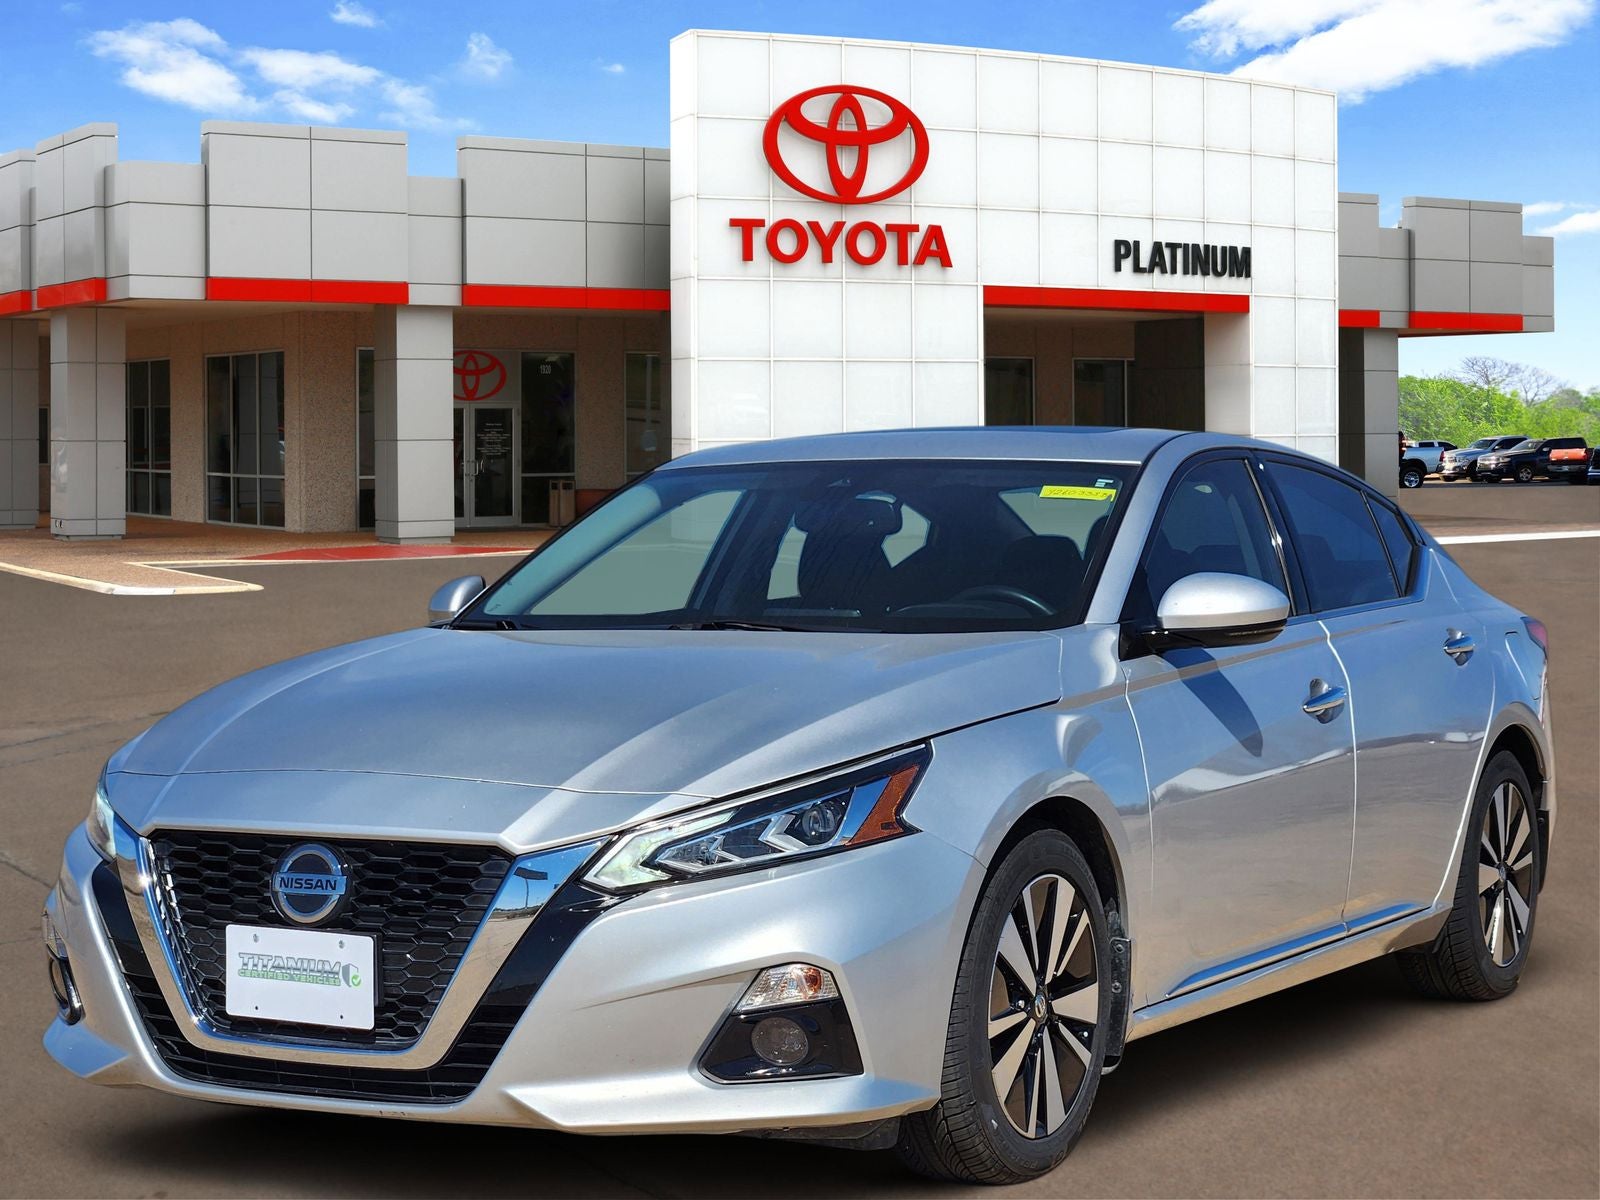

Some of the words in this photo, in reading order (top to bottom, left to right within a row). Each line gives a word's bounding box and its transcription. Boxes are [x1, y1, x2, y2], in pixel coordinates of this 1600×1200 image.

[730, 218, 953, 268] TOYOTA
[1114, 240, 1252, 278] PLATINUM
[279, 877, 337, 891] NISSAN
[238, 952, 341, 977] TITANIUM
[238, 969, 290, 981] CERTIFIED
[294, 974, 341, 987] VEHICLES
